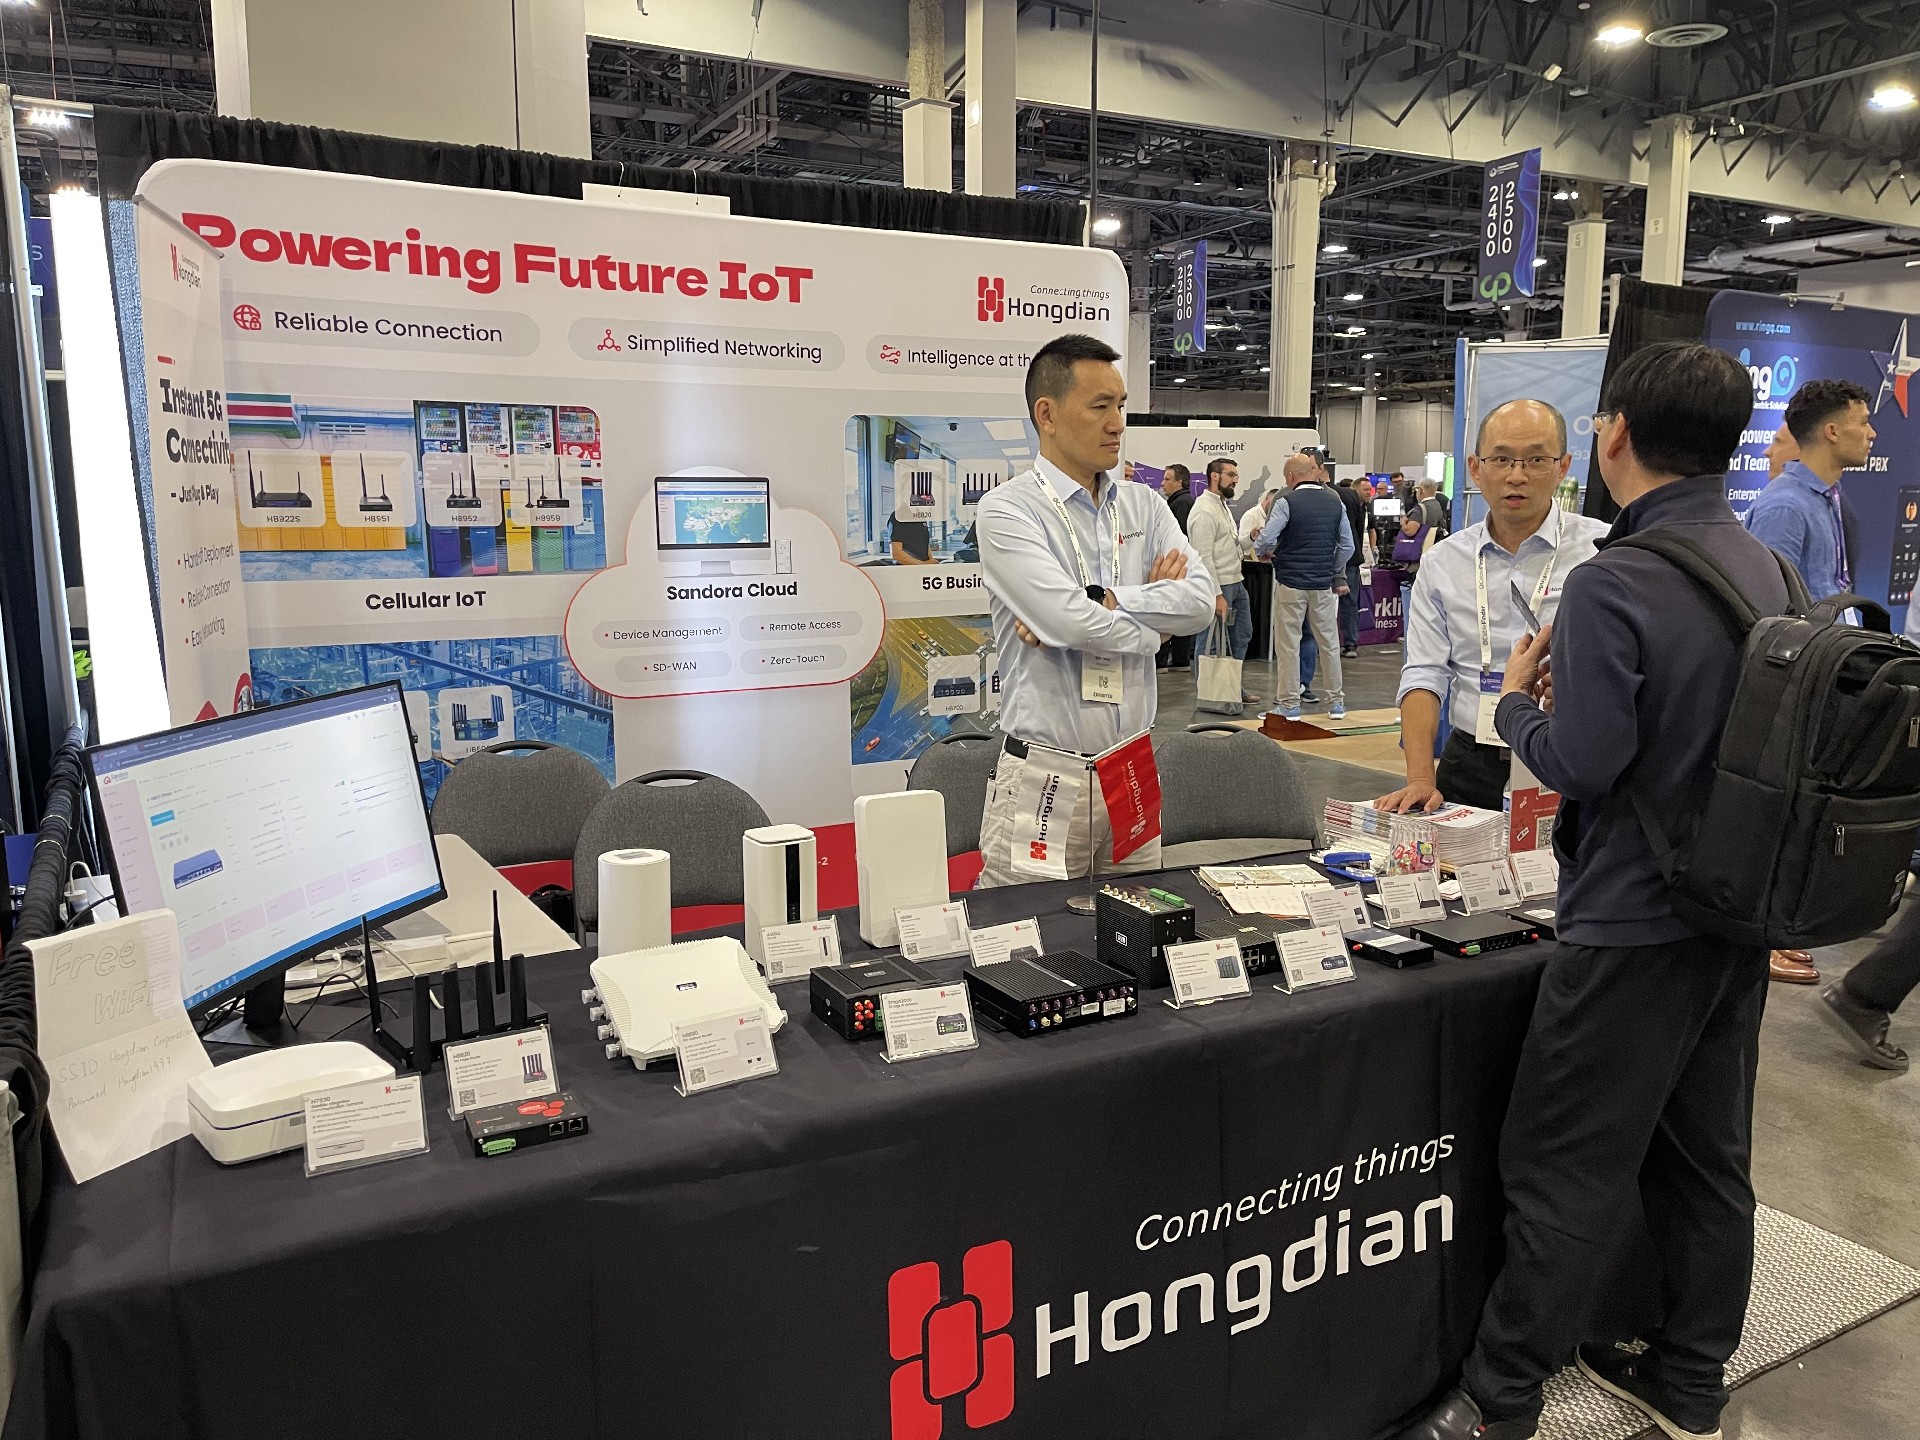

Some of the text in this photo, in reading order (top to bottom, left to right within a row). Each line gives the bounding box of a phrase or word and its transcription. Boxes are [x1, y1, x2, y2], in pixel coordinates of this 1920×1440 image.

[182, 211, 814, 303] Powering Future IoT
[1030, 285, 1110, 300] Connecting things
[1009, 298, 1110, 323] Hongdian
[274, 311, 503, 342] Reliable Connection
[627, 333, 823, 363] Simplified Networking
[907, 349, 1032, 369] Intelligence at th
[160, 378, 205, 419] Instant
[1198, 441, 1245, 453] Sparklight
[1869, 457, 1889, 472] PBX
[1728, 488, 1761, 502] Enterpri
[666, 582, 798, 601] Sandora Cloud
[922, 577, 942, 590] 5G
[365, 590, 487, 610] Cellular IoT
[613, 626, 722, 641] Device Management
[769, 620, 842, 632] Remote Access
[653, 661, 697, 672] SD-WAN
[770, 654, 825, 665] Zero-Touch
[1127, 760, 1145, 825] Hongdian
[1038, 775, 1060, 841] Hongdian
[50, 940, 136, 986] Free
[94, 980, 155, 1024] WiFi
[58, 1059, 98, 1084] SSID
[1135, 1134, 1455, 1251] Connecting things
[1036, 1194, 1453, 1378] Hongdian
